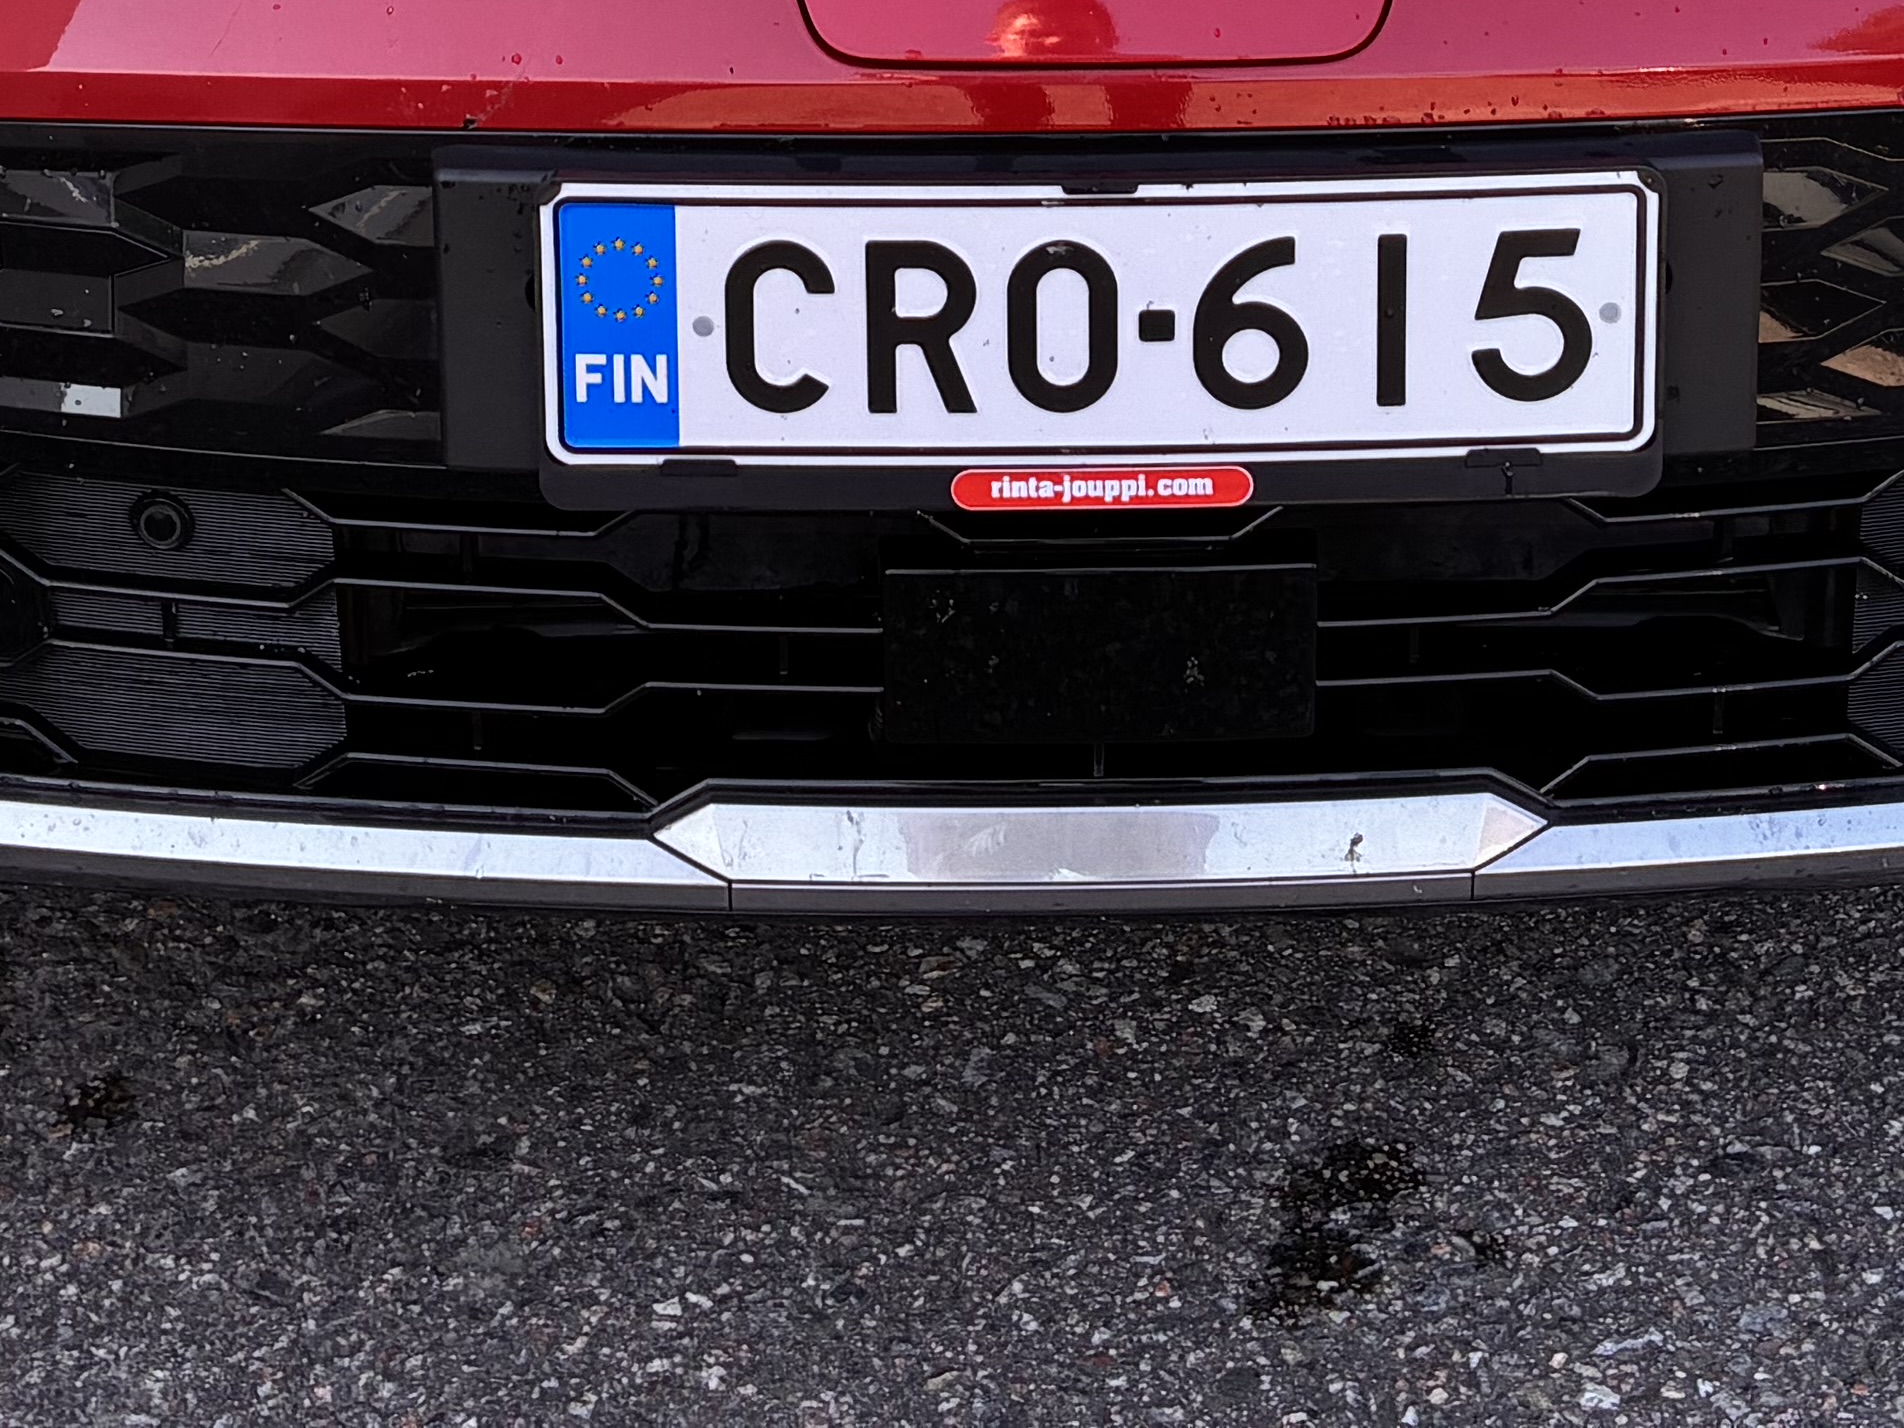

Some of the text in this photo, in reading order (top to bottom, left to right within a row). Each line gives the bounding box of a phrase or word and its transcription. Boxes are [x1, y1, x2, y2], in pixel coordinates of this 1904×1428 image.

[723, 227, 1594, 414] CRO-615
[575, 353, 669, 404] FIN
[991, 473, 1214, 503] rinta-jouppi.com
